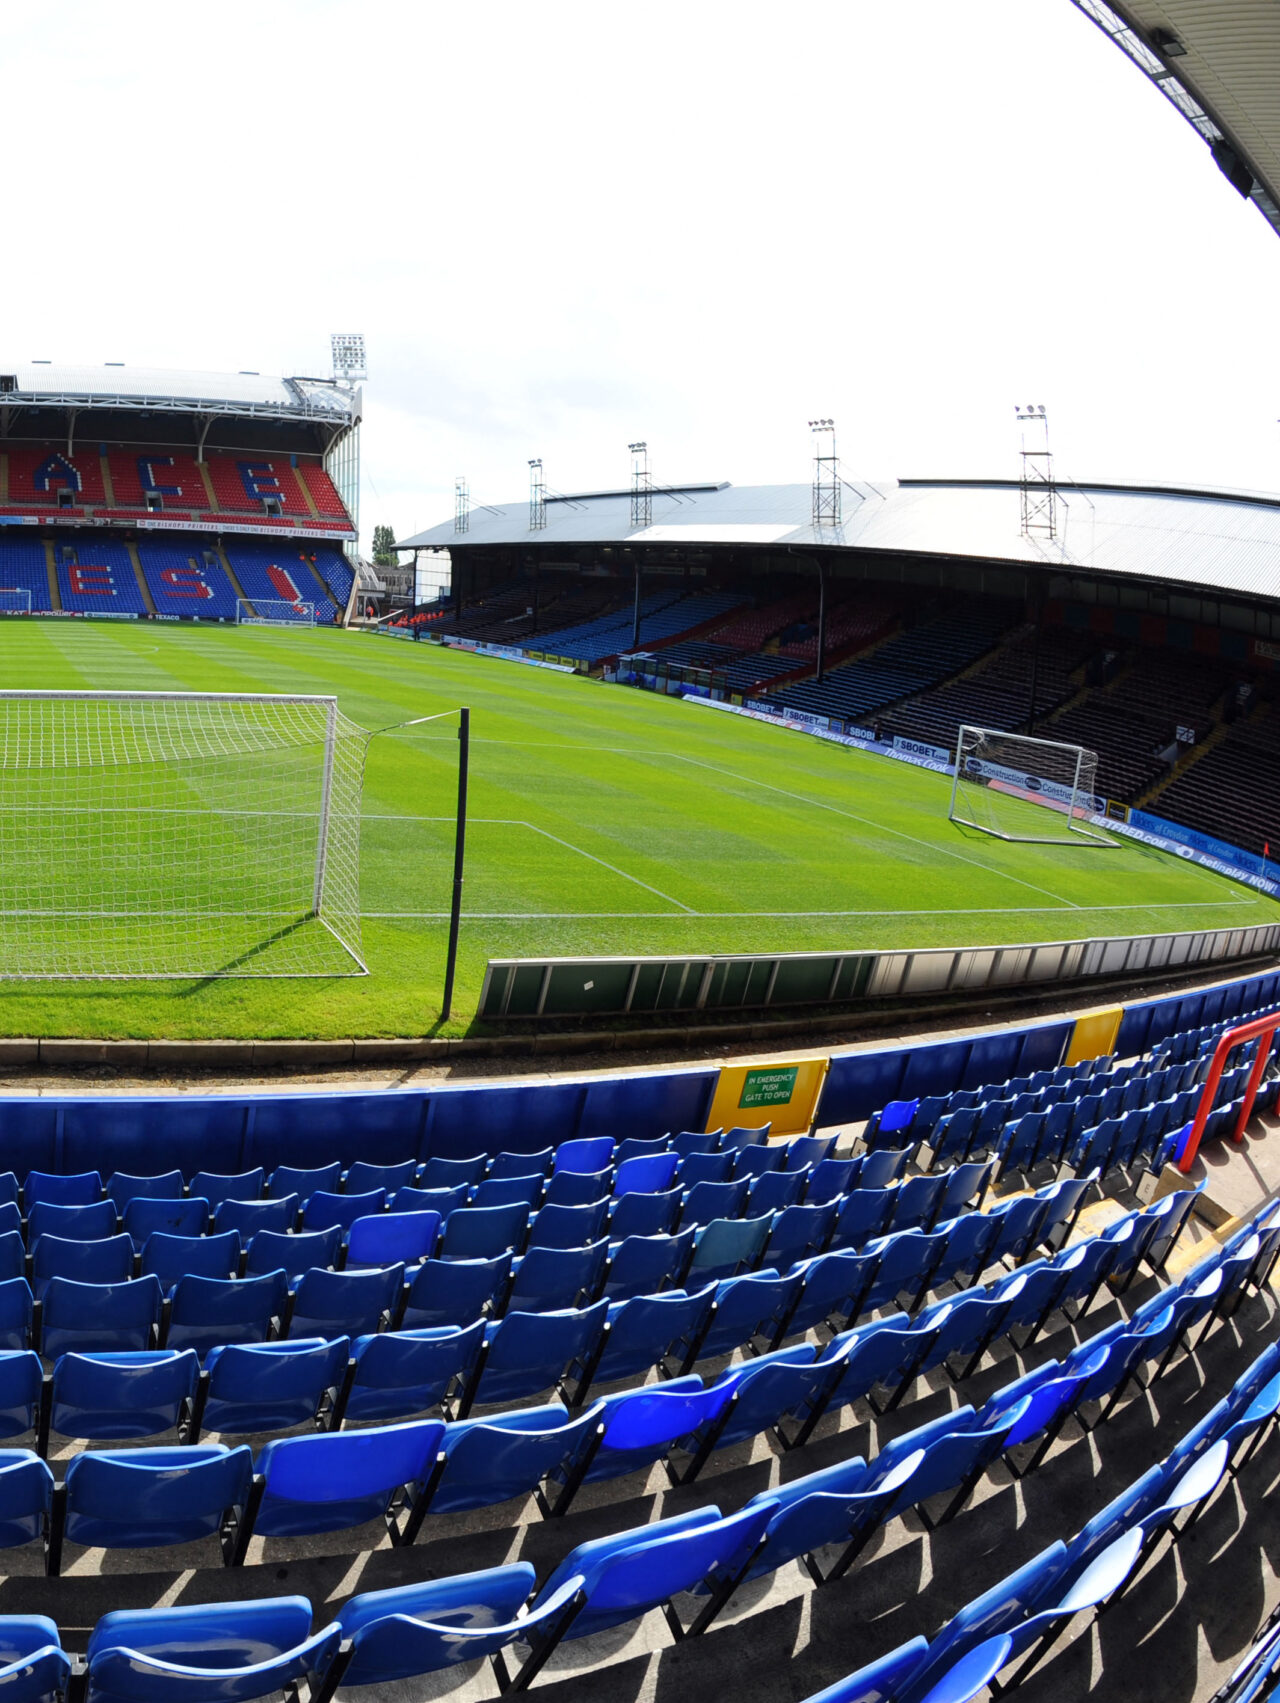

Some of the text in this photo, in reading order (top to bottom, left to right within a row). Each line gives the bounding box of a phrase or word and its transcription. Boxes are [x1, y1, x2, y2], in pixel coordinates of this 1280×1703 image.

[810, 727, 870, 750] Thomas Cook
[883, 747, 950, 773] Thomas Cook
[982, 764, 1024, 784] Construction
[1090, 815, 1168, 849] BETFRED.COM
[1199, 855, 1278, 895] betinplay NOW!
[756, 1074, 793, 1084] EMERGENCY
[745, 1093, 762, 1102] GATE
